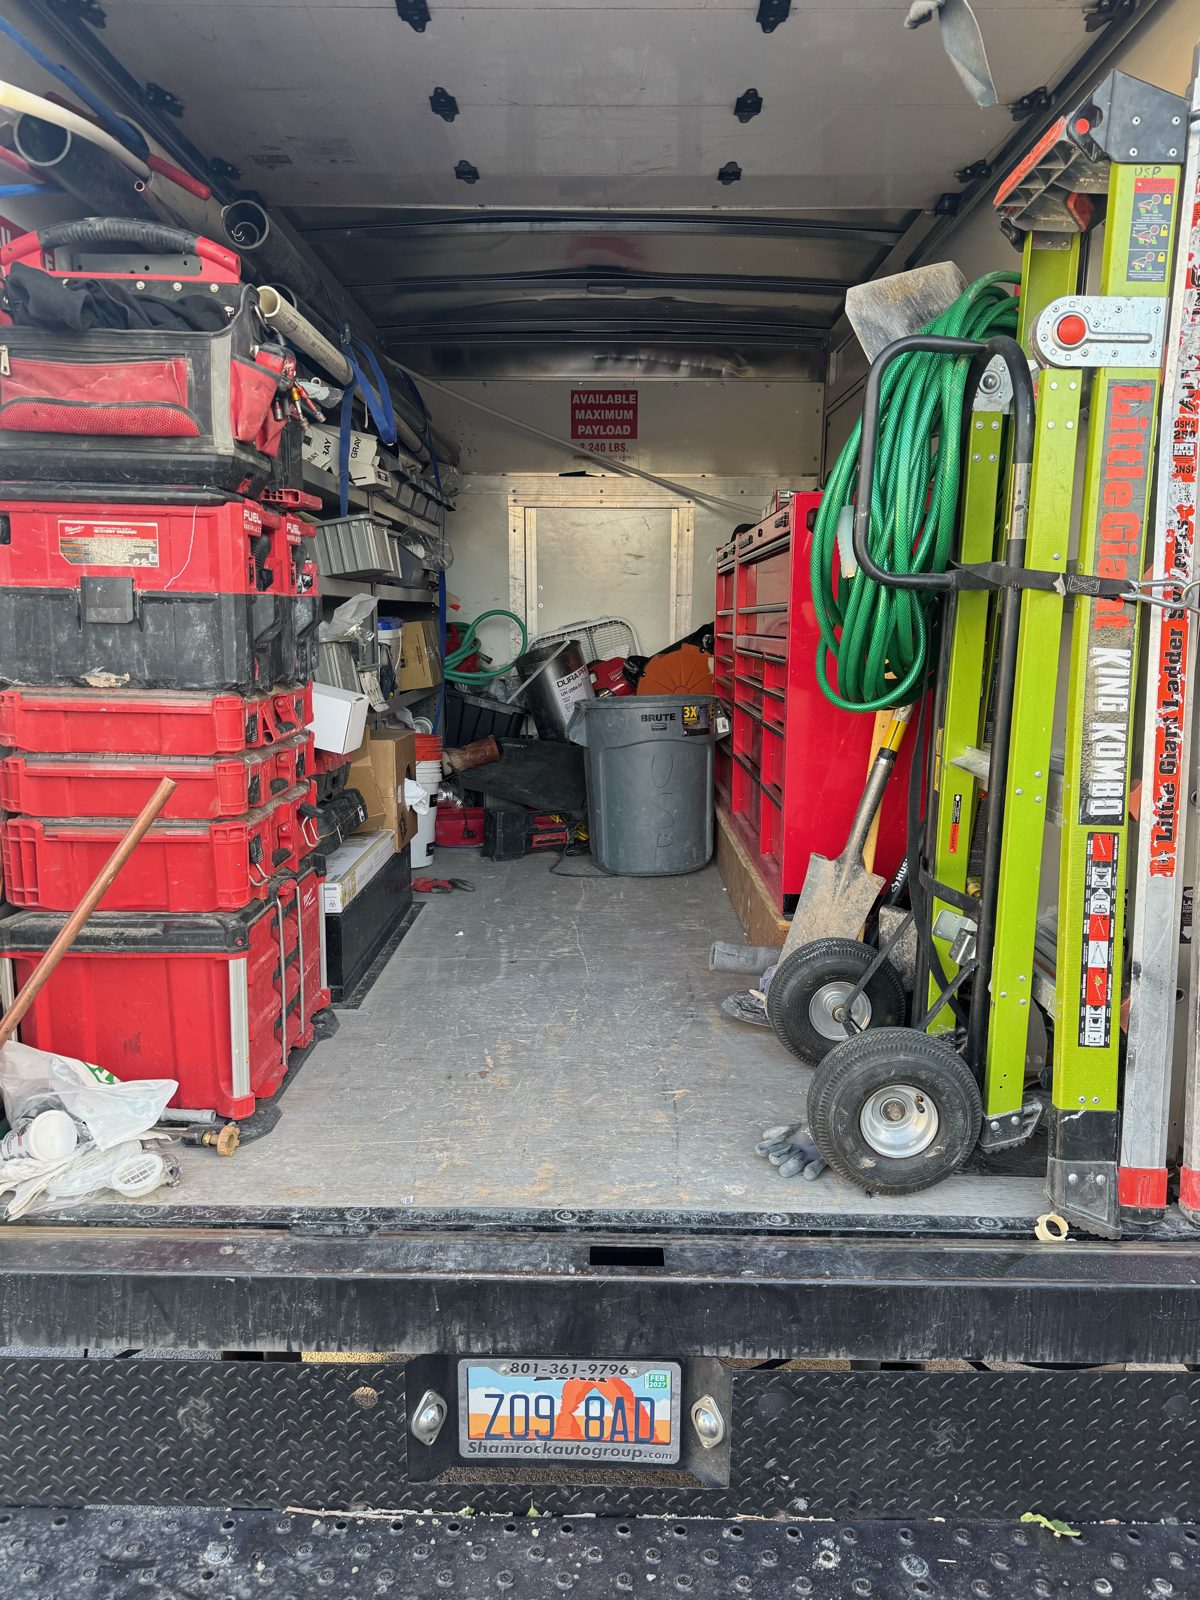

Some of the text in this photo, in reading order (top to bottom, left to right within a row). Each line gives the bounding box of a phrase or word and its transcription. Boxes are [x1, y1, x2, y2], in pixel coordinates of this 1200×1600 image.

[572, 394, 637, 404] AVAILABLE
[575, 410, 634, 420] MAXIMUM
[577, 425, 631, 435] PAYLOAD
[1174, 420, 1196, 429] OSHA
[322, 437, 332, 456] RAY
[351, 436, 362, 459] GRAY
[306, 451, 320, 463] RAY
[1093, 385, 1152, 630] Little Giant
[243, 509, 262, 524] FUEL
[640, 712, 676, 722] BRUTE
[683, 706, 697, 718] 3X
[1087, 647, 1132, 816] KING KOMBO
[895, 857, 909, 882] HUS
[509, 1362, 630, 1376] 801-361-9796
[649, 1374, 666, 1382] FEB
[583, 1395, 656, 1443] 8AD
[467, 1441, 673, 1460] Shamrockautogroup.com
